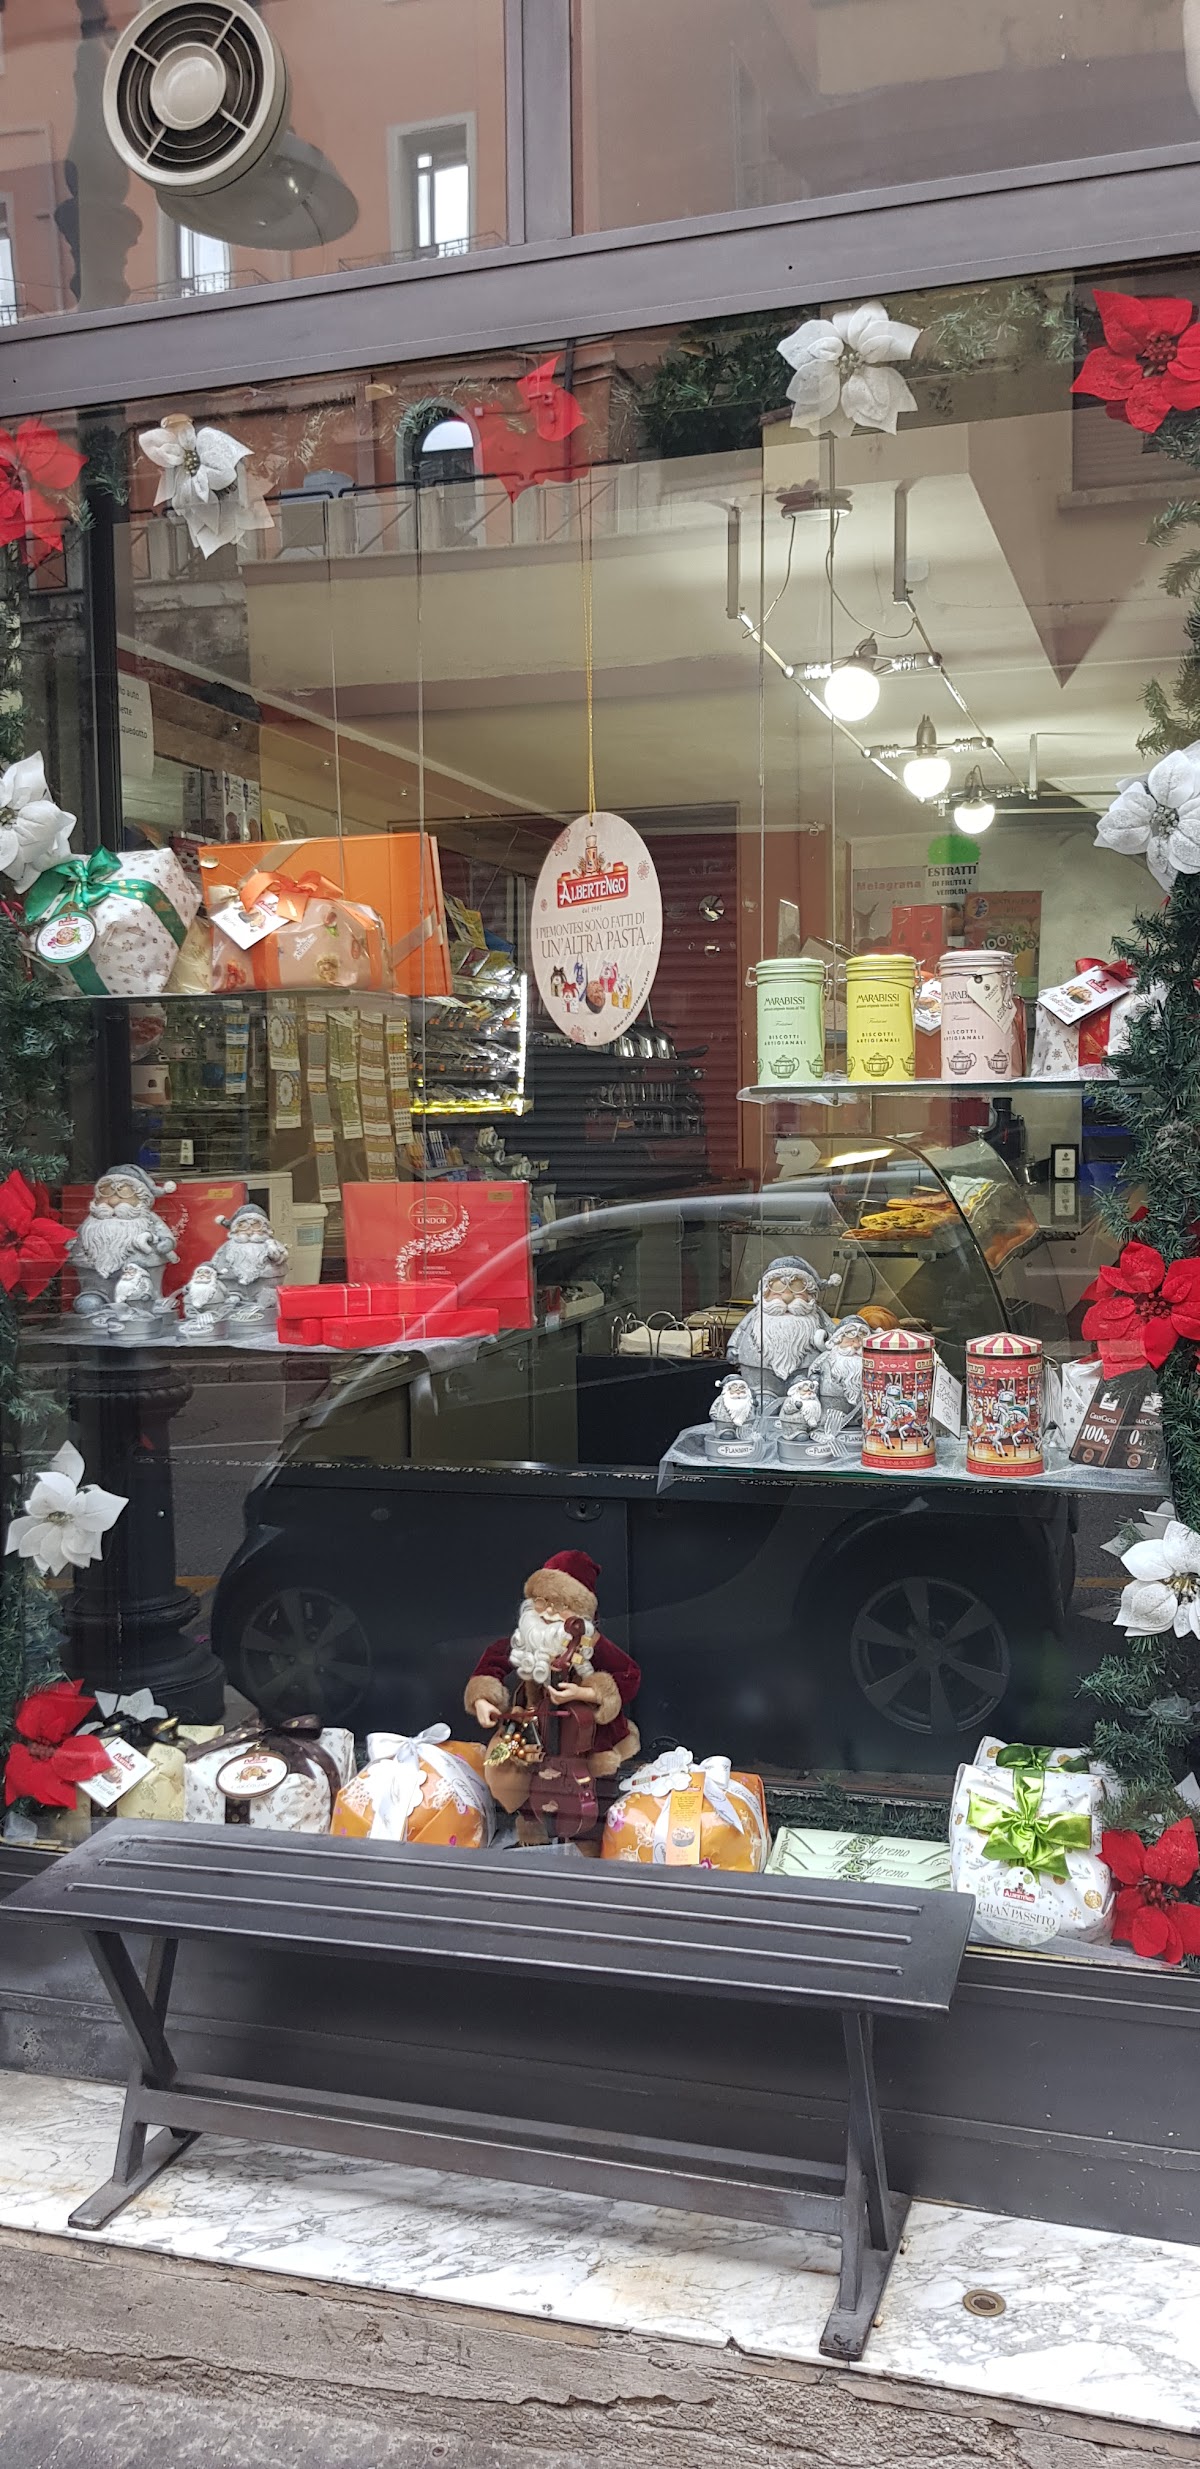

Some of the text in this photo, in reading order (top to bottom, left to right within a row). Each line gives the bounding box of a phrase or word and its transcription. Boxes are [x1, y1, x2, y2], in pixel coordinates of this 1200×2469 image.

[928, 865, 977, 877] ESTRATTI
[559, 875, 626, 905] ALBERTENGO
[856, 880, 922, 892] Melagrana
[941, 878, 966, 887] FRUTTA
[540, 921, 584, 939] PIEMONTESI
[585, 917, 610, 932] SONO
[611, 913, 634, 929] FATTI
[635, 911, 645, 925] DI
[541, 932, 604, 959] UN'ALTRA
[764, 996, 806, 1007] MARABISSI
[856, 993, 900, 1004] MARABISSI
[417, 1217, 447, 1225] LINDOR
[1081, 1425, 1110, 1445] 100%
[856, 1834, 911, 1857] Supremo
[853, 1859, 910, 1879] Supremo
[978, 1902, 1009, 1917] GRAN
[1011, 1908, 1056, 1927] PASSITO
